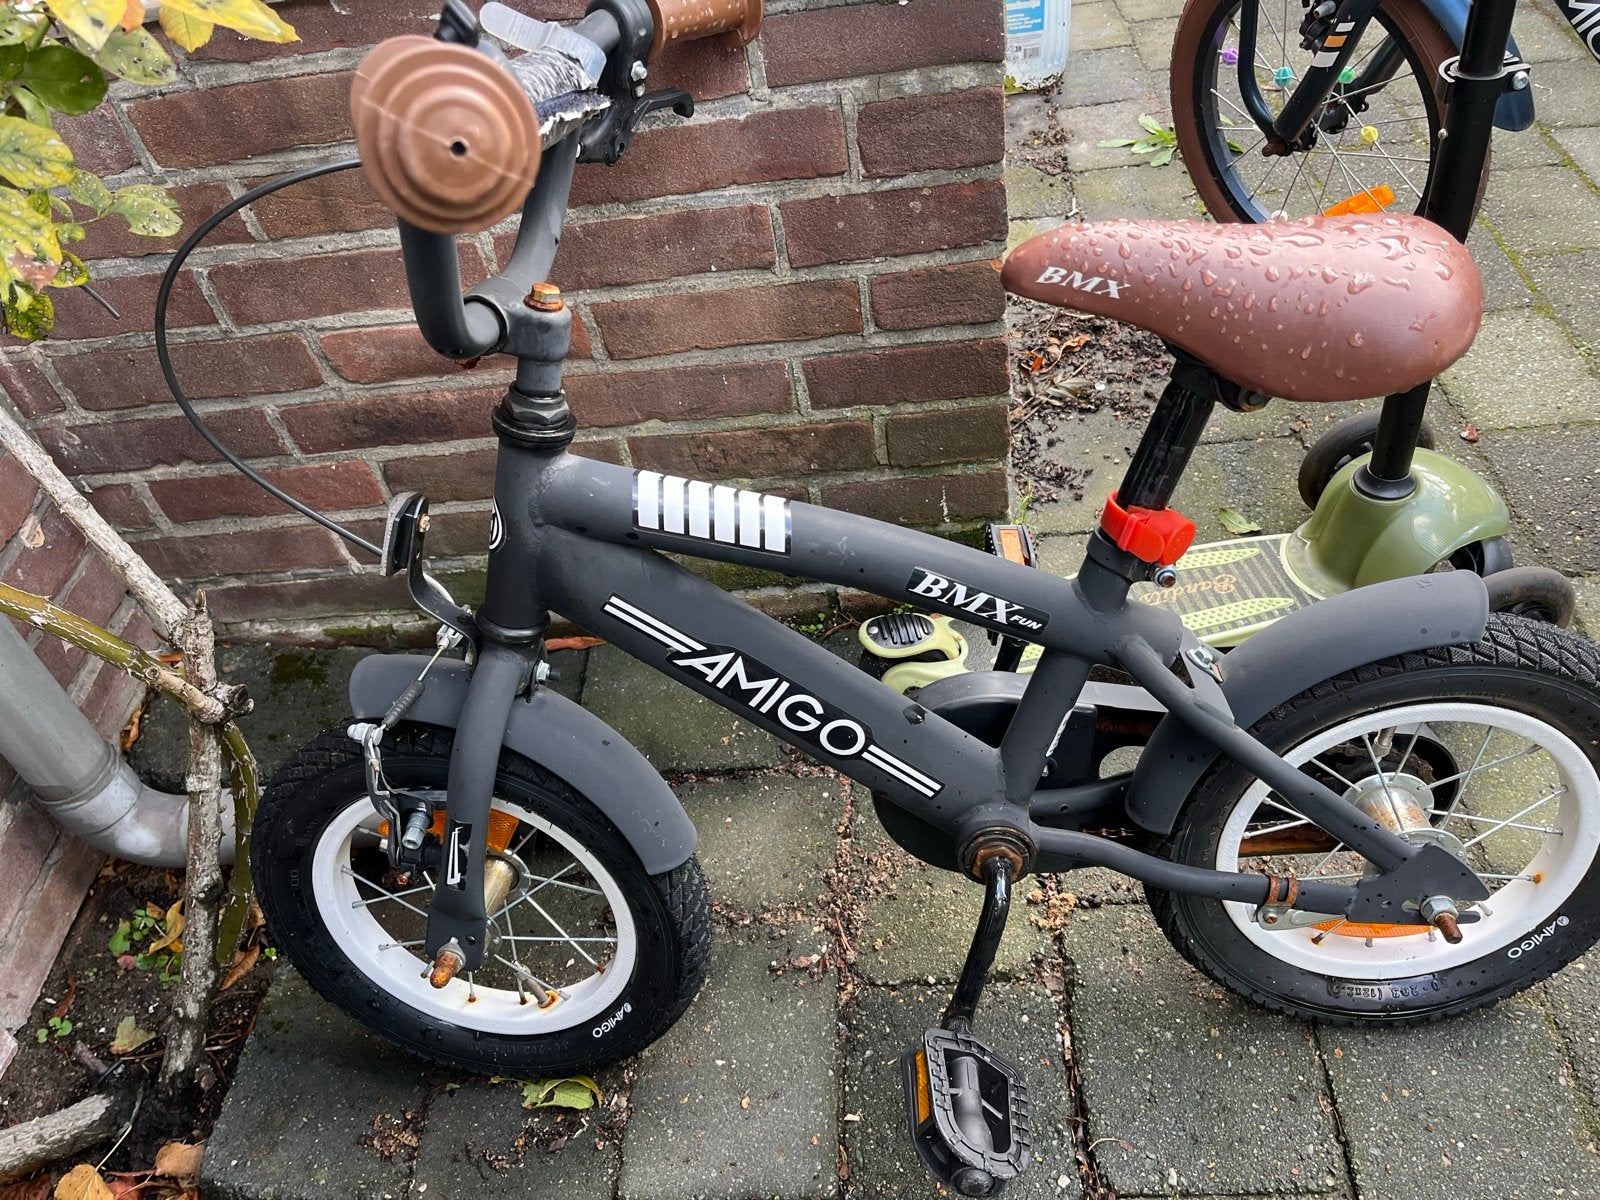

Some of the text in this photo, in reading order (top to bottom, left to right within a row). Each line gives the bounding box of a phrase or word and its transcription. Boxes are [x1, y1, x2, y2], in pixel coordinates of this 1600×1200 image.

[1035, 266, 1131, 299] BMX
[908, 571, 1043, 630] BMX FUN
[672, 652, 866, 756] AMIGO
[1507, 920, 1557, 959] AMIGO
[592, 1005, 625, 1038] AMIGO
